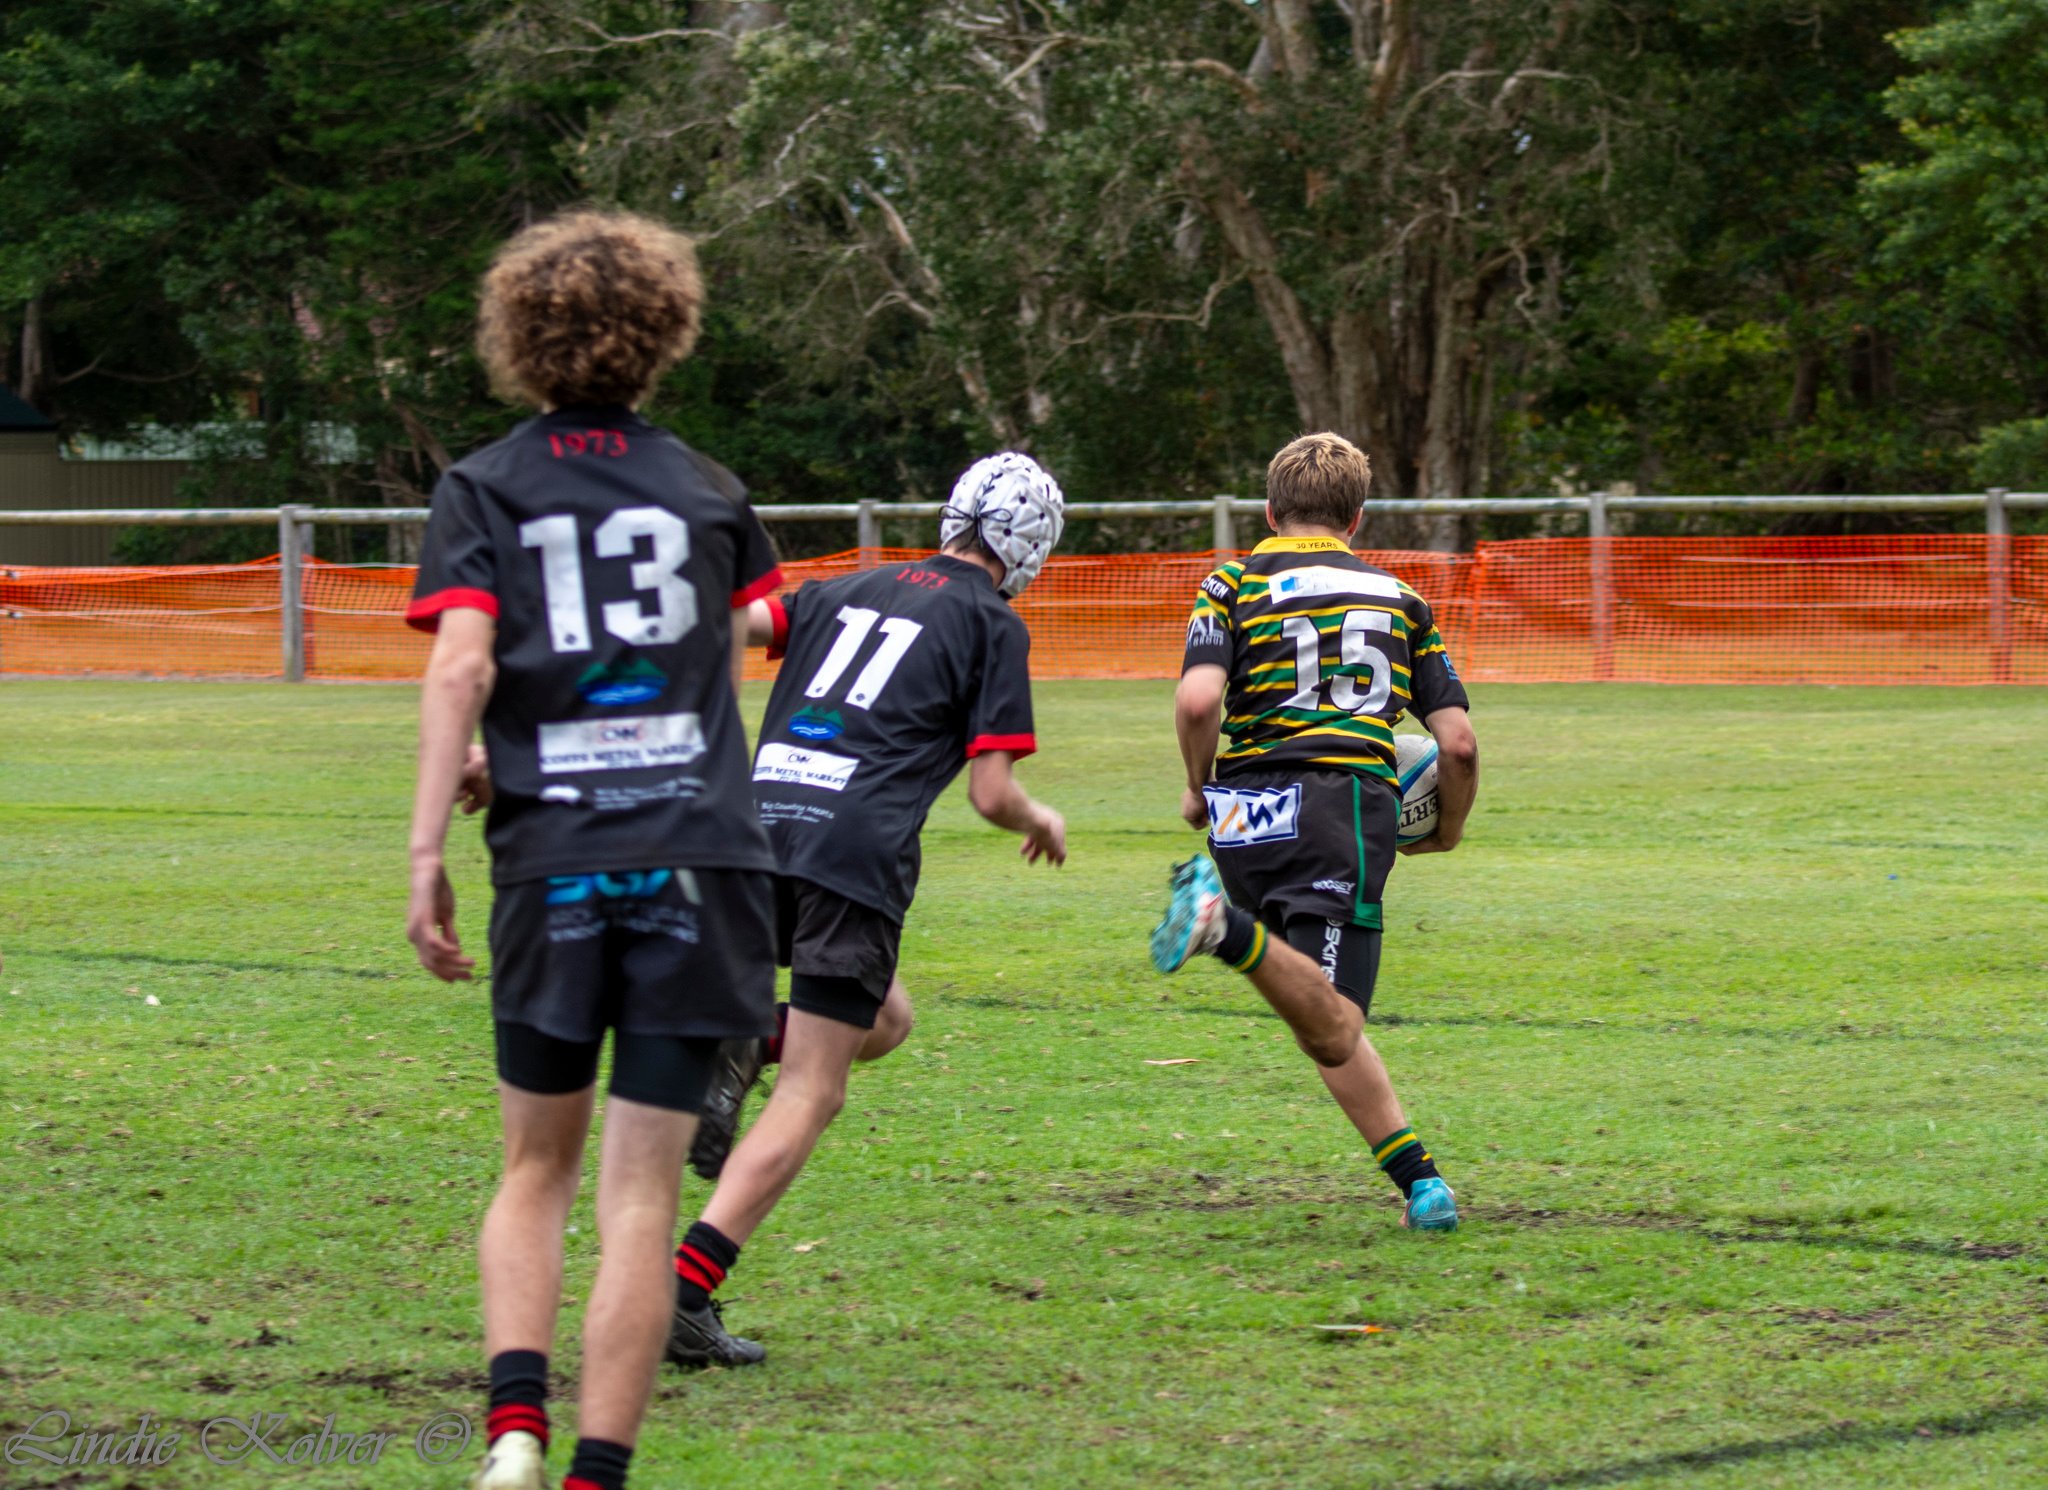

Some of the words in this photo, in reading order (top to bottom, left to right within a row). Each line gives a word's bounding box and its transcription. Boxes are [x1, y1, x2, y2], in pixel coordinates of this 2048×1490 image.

[549, 429, 628, 458] 1973
[519, 506, 698, 653] 13
[896, 568, 949, 590] 1973
[1308, 542, 1339, 550] YEARS
[804, 605, 924, 711] 11
[1276, 610, 1393, 716] 15
